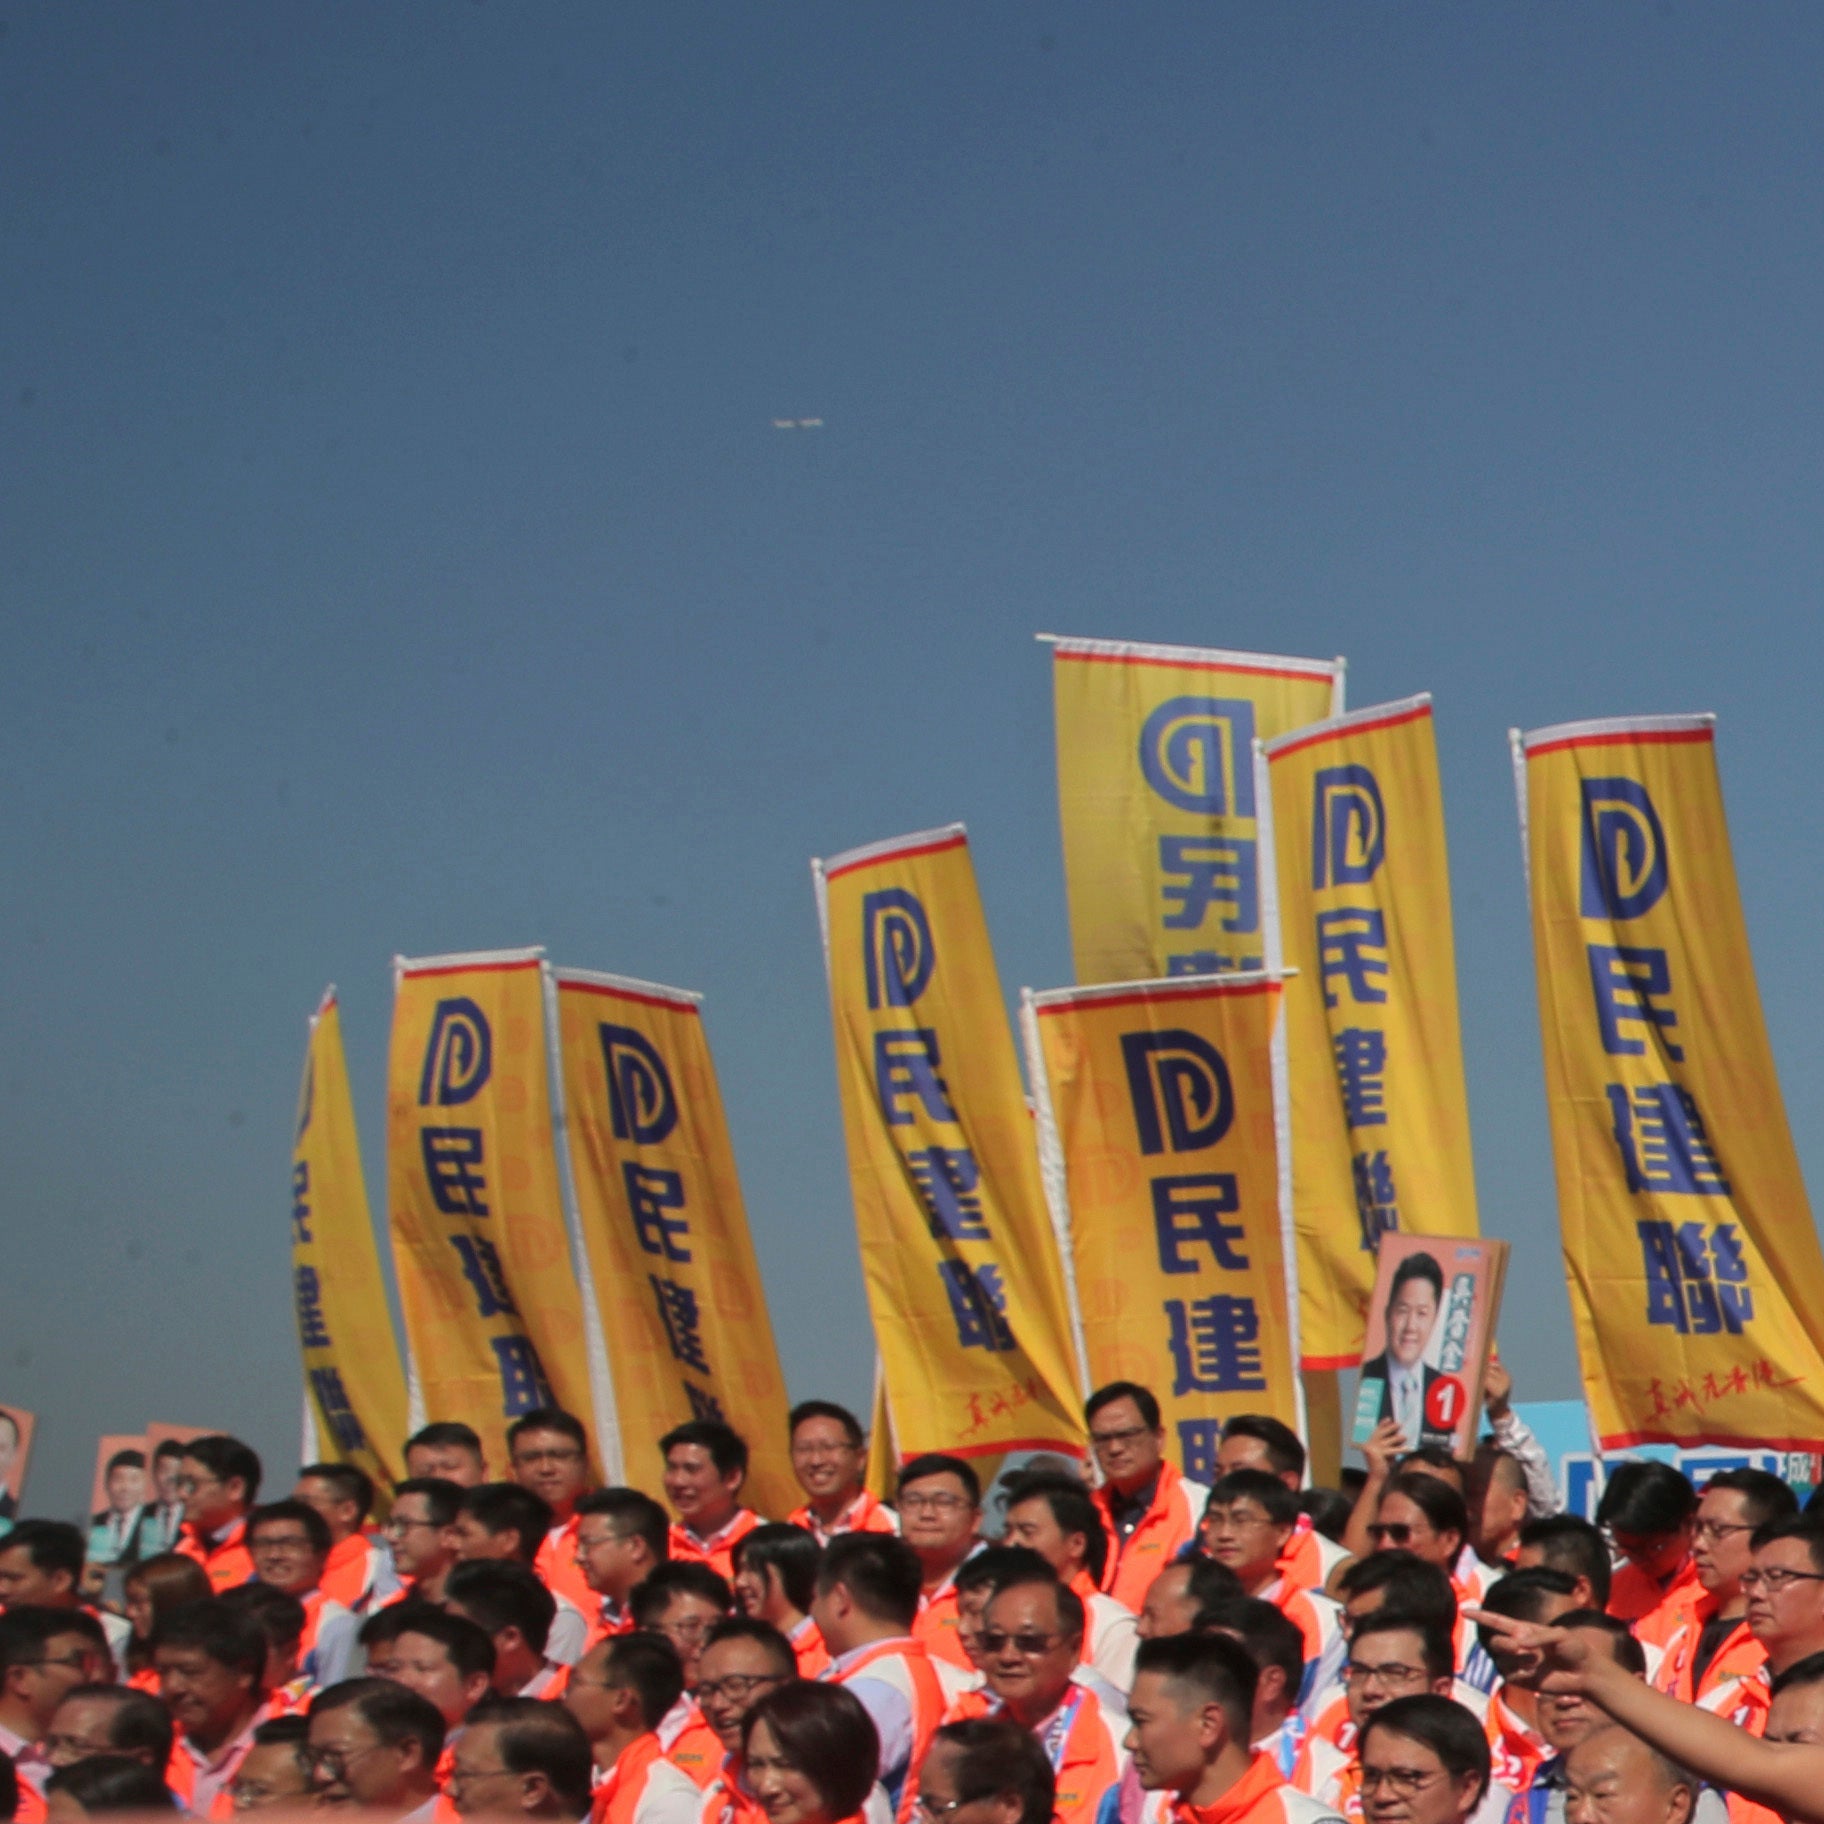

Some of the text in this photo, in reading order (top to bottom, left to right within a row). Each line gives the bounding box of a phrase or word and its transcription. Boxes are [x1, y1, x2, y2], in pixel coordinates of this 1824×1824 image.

[873, 1028, 1015, 1355] 民建聯
[1587, 944, 1756, 1335] 民建聯
[1436, 1383, 1455, 1422] 1
